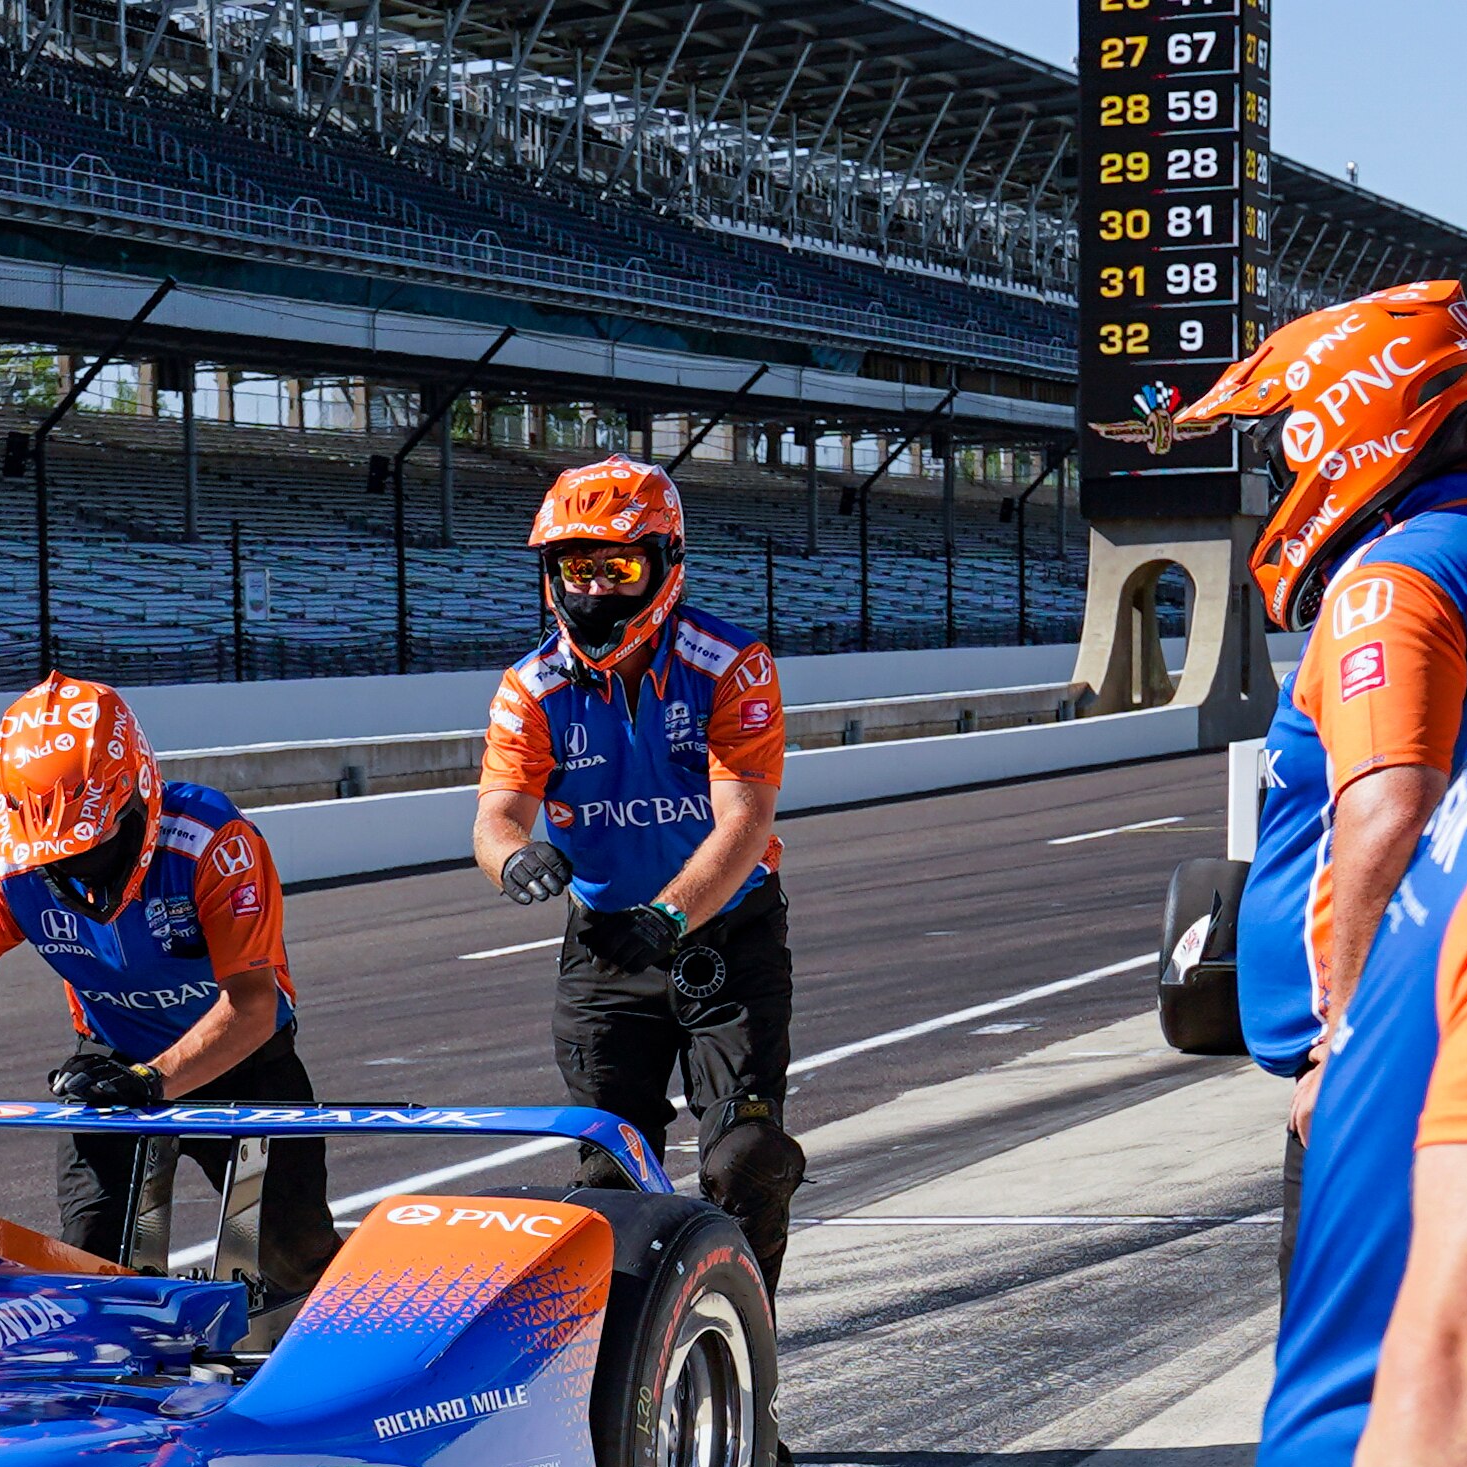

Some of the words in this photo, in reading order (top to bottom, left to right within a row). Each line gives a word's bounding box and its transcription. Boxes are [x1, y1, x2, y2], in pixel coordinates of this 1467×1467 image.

[1100, 36, 1149, 69] 27
[1167, 31, 1217, 65] 67
[1100, 94, 1151, 126] 28
[1167, 90, 1218, 122] 59
[1100, 152, 1151, 184] 29
[1167, 148, 1218, 180] 28
[1099, 209, 1151, 241] 30
[1167, 206, 1214, 238] 81
[1099, 266, 1145, 298] 31
[1167, 263, 1218, 296] 98
[1099, 323, 1151, 355] 32
[1179, 320, 1204, 351] 9
[1305, 314, 1366, 364] PNC
[1316, 336, 1426, 427] PNC
[1347, 428, 1414, 469] PNC
[568, 472, 610, 489] PNC
[623, 493, 648, 521] PNC
[1299, 494, 1346, 547] PNC
[565, 523, 607, 536] PNC
[113, 705, 129, 741] PNC
[13, 740, 53, 769] PNC
[554, 754, 608, 772] NDA
[81, 778, 106, 820] PNC
[579, 793, 715, 828] PNCBAN
[32, 839, 75, 858] PNC
[80, 979, 219, 1011] PNCBAN
[445, 1208, 563, 1238] PNC
[374, 1397, 467, 1439] RICHARD
[471, 1384, 528, 1414] MILLE
